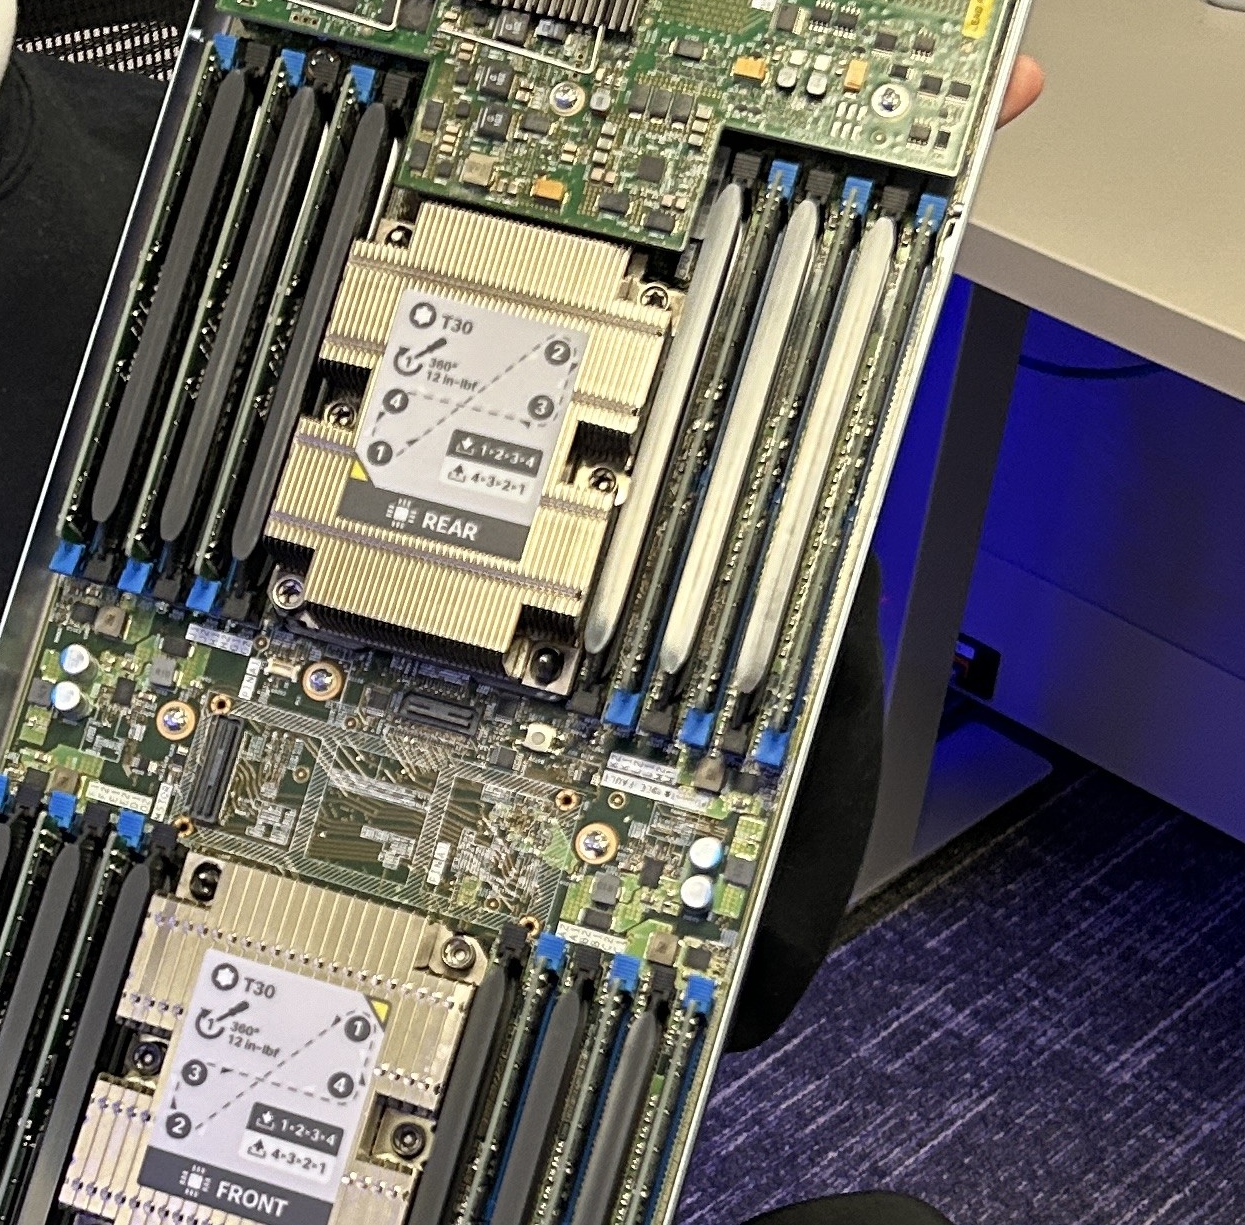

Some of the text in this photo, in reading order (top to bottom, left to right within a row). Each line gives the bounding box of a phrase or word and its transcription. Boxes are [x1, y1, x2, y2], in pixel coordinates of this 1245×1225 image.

[441, 313, 474, 336] T30
[550, 345, 564, 360] 2
[426, 370, 440, 384] 12
[389, 394, 401, 408] 4
[536, 400, 547, 415] 3
[375, 446, 384, 461] 1
[421, 511, 479, 541] REAR
[244, 976, 276, 999] T30
[353, 1022, 362, 1036] 1
[228, 1034, 242, 1048] 12
[188, 1065, 201, 1080] 3
[333, 1077, 346, 1092] 4
[172, 1117, 185, 1133] 2
[216, 1180, 289, 1218] FRONT
